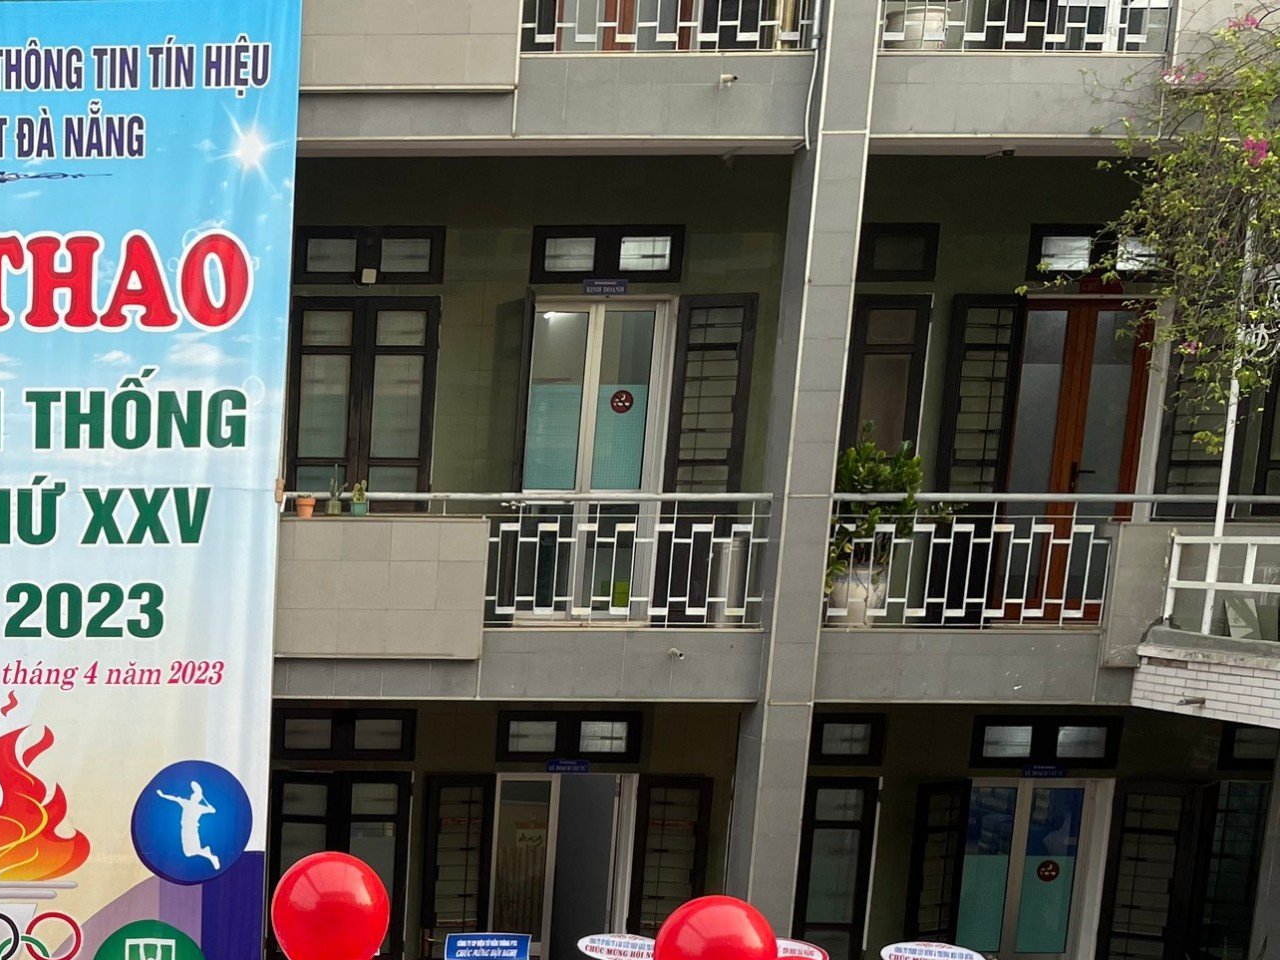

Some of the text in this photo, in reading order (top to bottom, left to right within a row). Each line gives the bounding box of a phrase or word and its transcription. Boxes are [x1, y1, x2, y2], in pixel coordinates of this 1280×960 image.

[93, 47, 136, 90] TIN
[149, 37, 195, 89] TÍN
[203, 35, 271, 96] HIỆU
[17, 107, 56, 158] ĐÀ
[64, 101, 145, 158] NẴNG
[26, 368, 247, 449] THỐNG
[81, 487, 211, 544] XXV
[4, 582, 164, 638] 2023
[1, 660, 78, 690] tháng
[83, 661, 98, 685] 4
[104, 660, 161, 685] năm
[167, 660, 225, 685] 2023
[585, 944, 605, 954] CHÚC
[606, 947, 628, 957] MỪNG
[630, 950, 644, 959] HỘI
